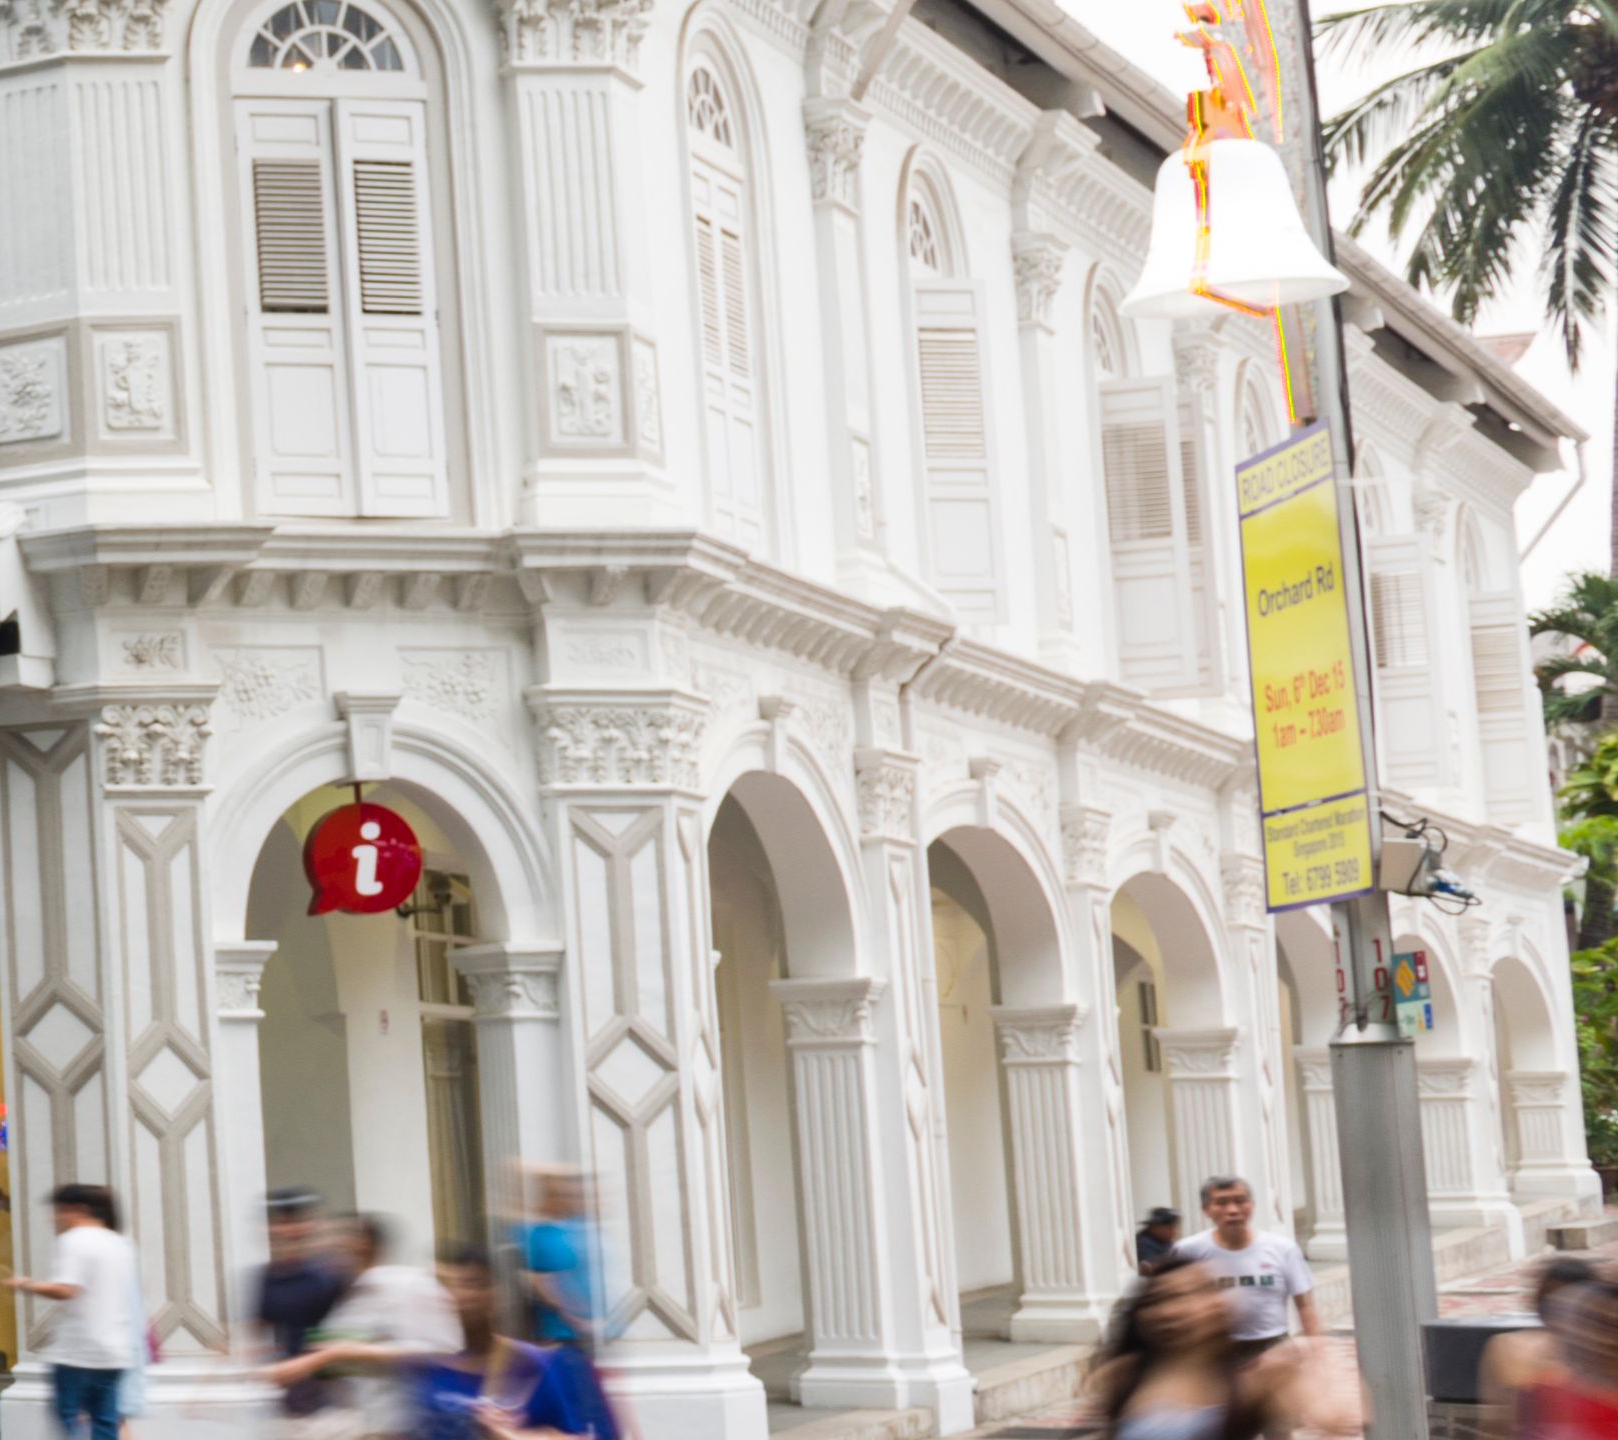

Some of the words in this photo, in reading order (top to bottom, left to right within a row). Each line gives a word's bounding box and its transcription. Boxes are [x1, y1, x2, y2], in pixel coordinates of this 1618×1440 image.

[1243, 467, 1274, 504] ROAD
[1276, 437, 1329, 488] CLOSURE
[1258, 571, 1314, 616] Orchard
[1316, 562, 1336, 594] Rd
[1265, 684, 1292, 713] Sun,
[1308, 670, 1331, 699] Dec
[1332, 660, 1346, 690] 15
[1273, 723, 1297, 748] 1am
[1371, 937, 1391, 1020] 107
